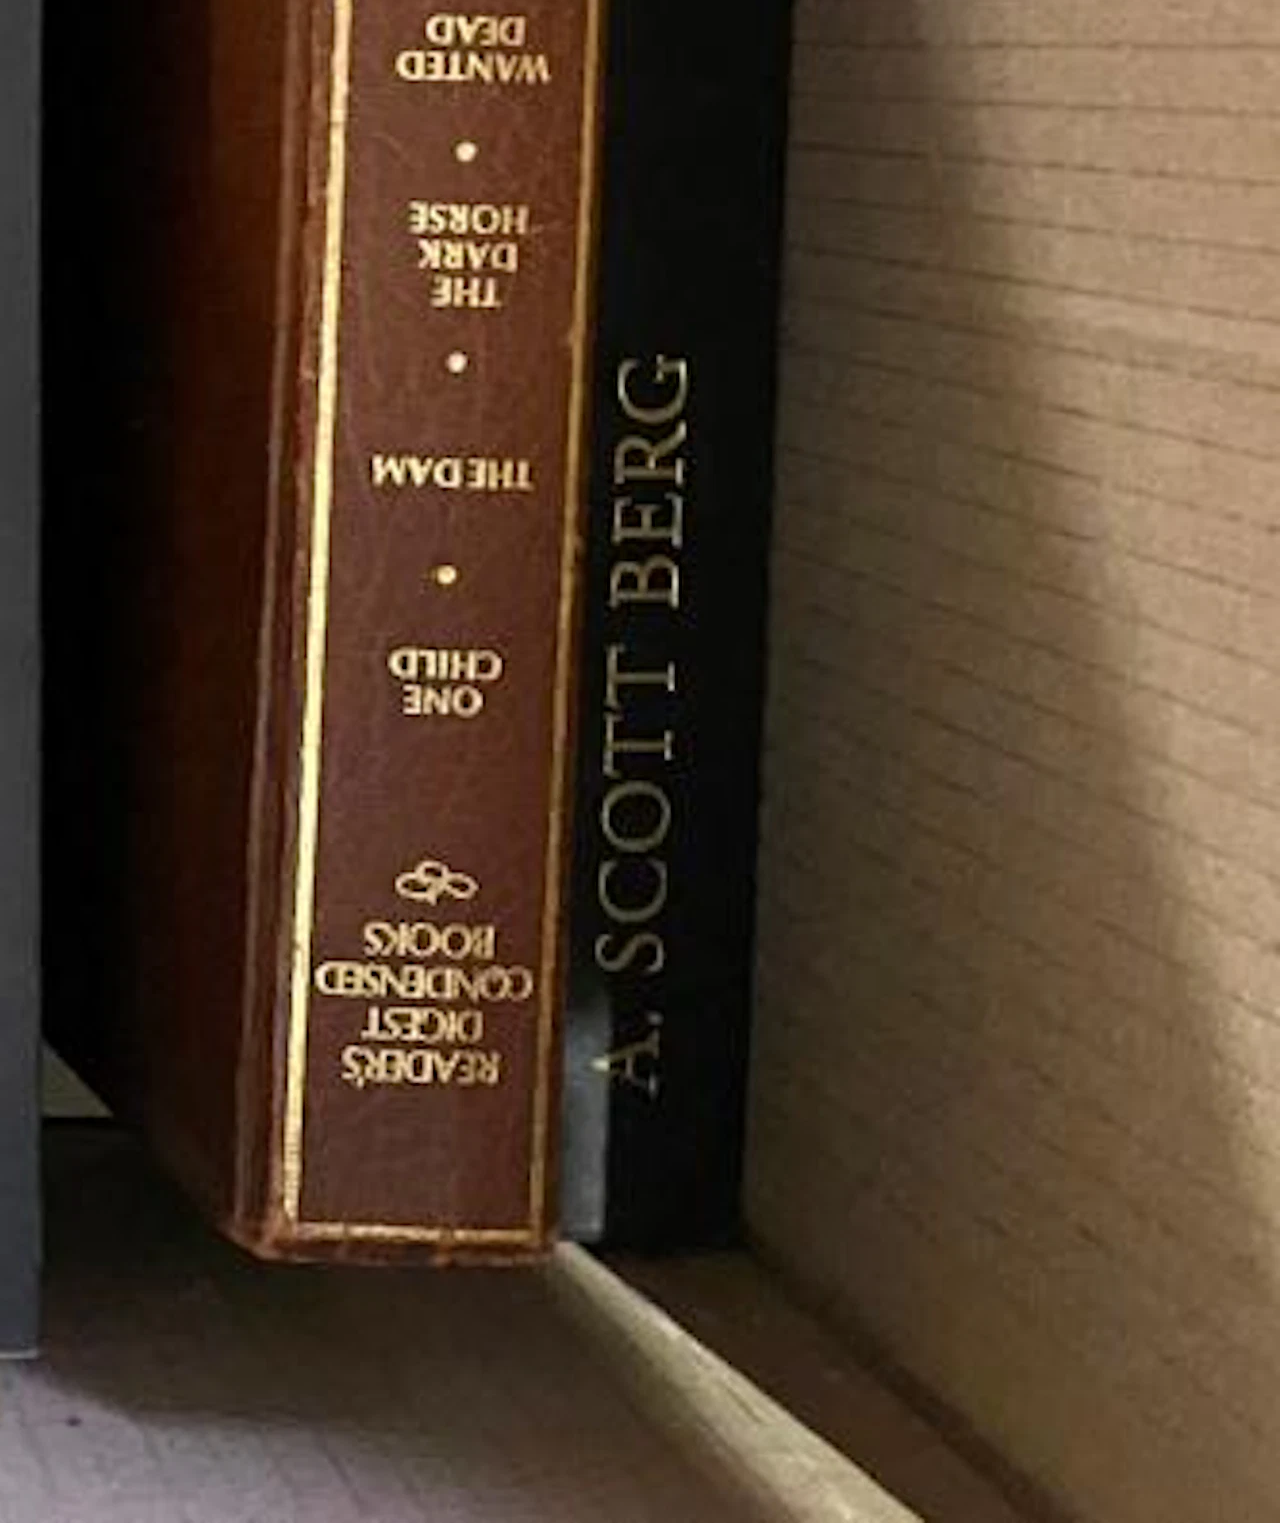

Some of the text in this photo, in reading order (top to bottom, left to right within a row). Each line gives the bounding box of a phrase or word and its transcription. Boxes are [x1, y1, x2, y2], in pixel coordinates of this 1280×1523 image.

[425, 14, 526, 46] DEAD
[395, 49, 551, 84] WANTED
[408, 199, 530, 236] HORSE
[417, 239, 518, 273] DARK
[430, 276, 504, 309] THE
[371, 452, 535, 491] THE DAM
[609, 353, 691, 611] BERG
[387, 648, 504, 683] CHILD
[402, 683, 484, 718] ONE
[594, 643, 676, 975] SCOTT
[363, 920, 496, 959] BOOKS
[314, 960, 534, 1002] CONDENSED
[361, 1004, 484, 1044] DIGEST
[341, 1045, 500, 1091] READER'S
